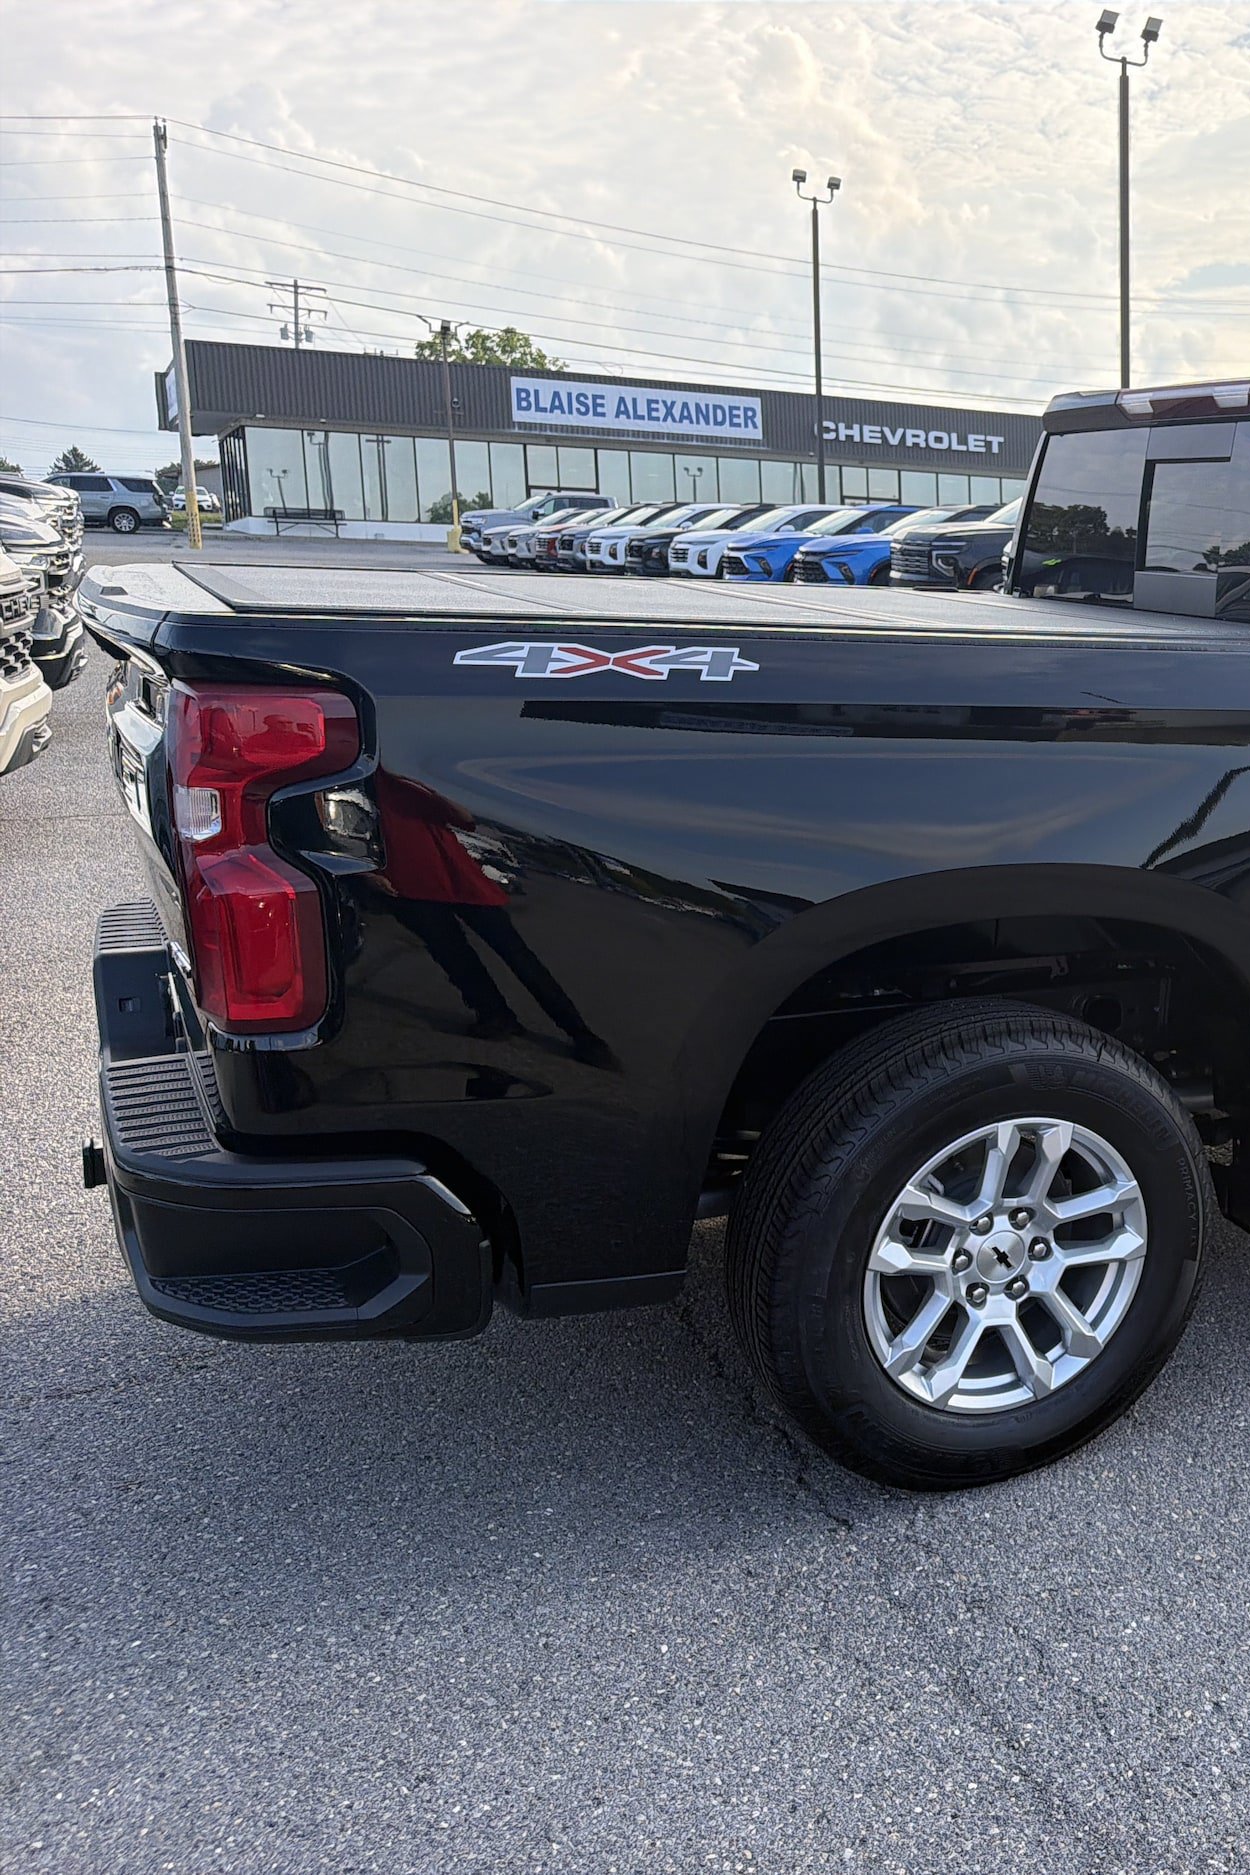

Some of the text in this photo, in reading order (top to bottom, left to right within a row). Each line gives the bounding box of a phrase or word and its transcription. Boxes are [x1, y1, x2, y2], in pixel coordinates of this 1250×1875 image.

[515, 387, 759, 430] BLAISE ALEXANDER
[814, 420, 1005, 454] CHEVROLET
[1177, 1157, 1198, 1221] PRIMACY
